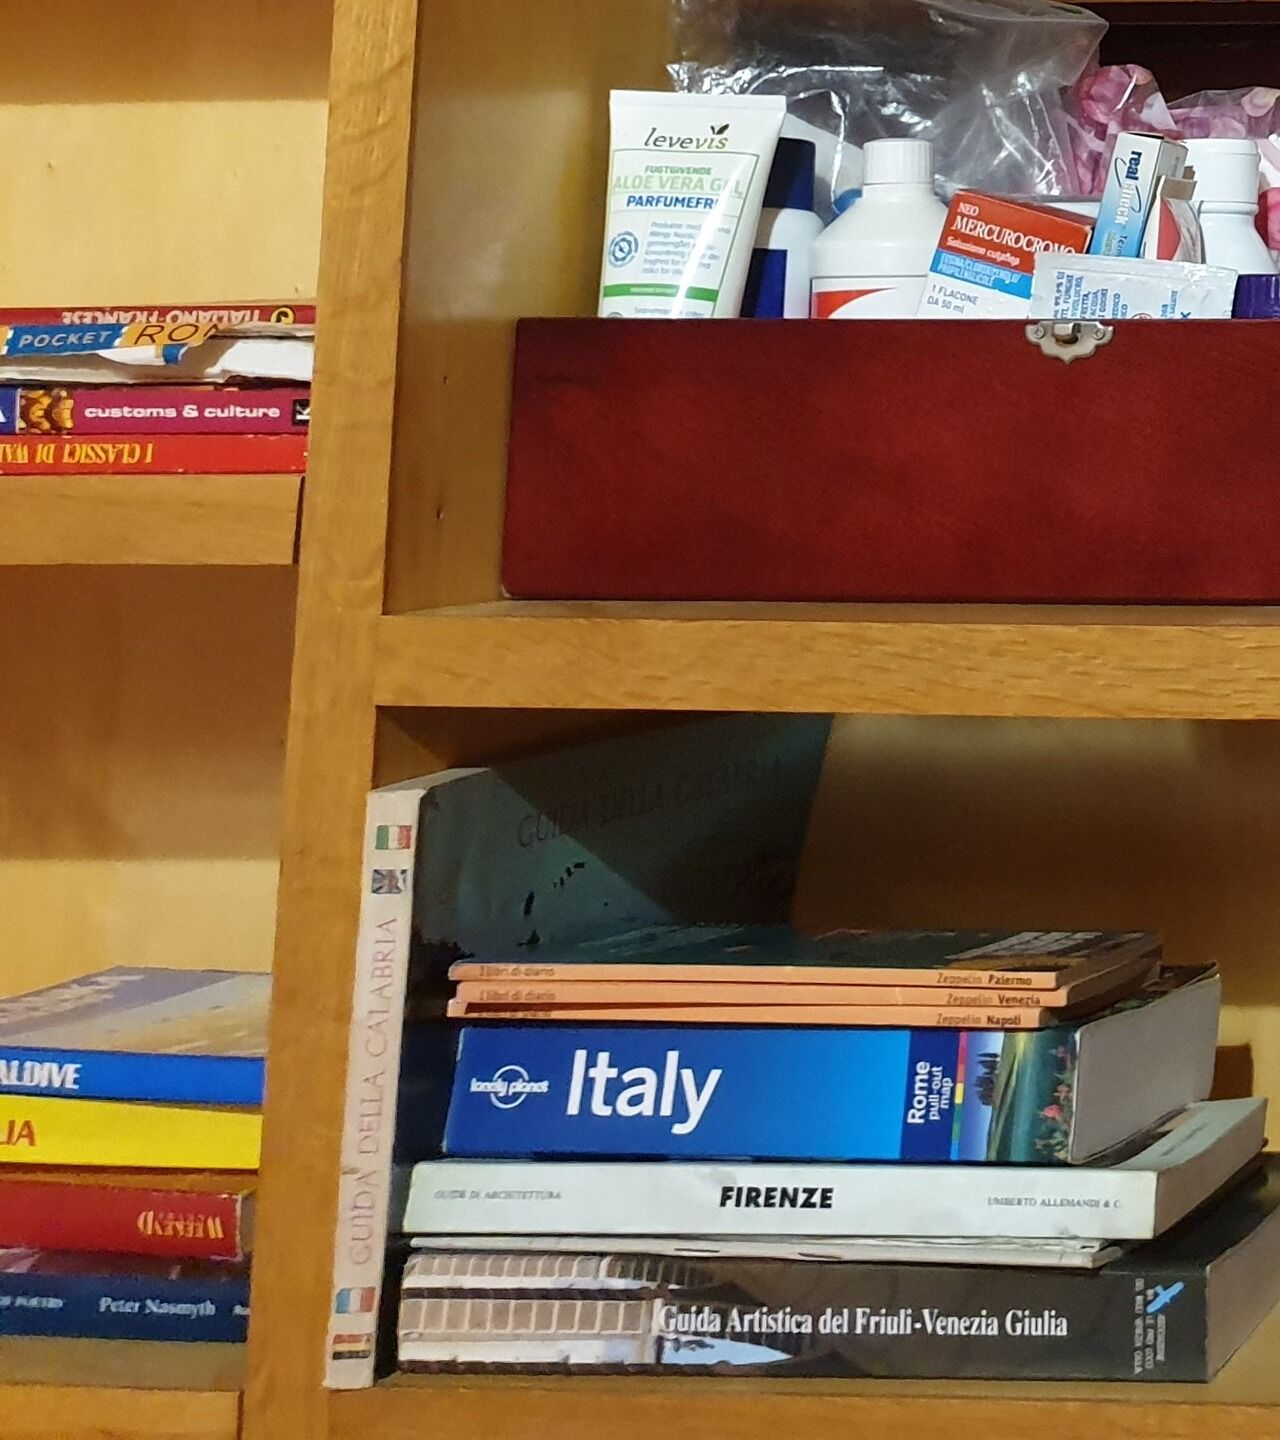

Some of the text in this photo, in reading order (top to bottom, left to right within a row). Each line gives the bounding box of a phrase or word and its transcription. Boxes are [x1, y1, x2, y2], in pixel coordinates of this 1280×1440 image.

[644, 127, 729, 150] levevis
[1125, 150, 1143, 181] real
[613, 175, 656, 192] ALOE
[658, 176, 705, 193] VERA
[956, 202, 979, 216] NEO
[926, 296, 940, 307] DA
[940, 299, 952, 311] 50
[938, 287, 980, 306] FLACONE
[18, 329, 113, 348] POCKET
[84, 404, 281, 419] customs & culture
[35, 442, 57, 464] DI
[63, 442, 143, 464] CLASSICI
[936, 972, 1033, 986] Zeppelin Palermo
[946, 992, 1041, 1006] Zeppelin Venezia
[936, 1012, 1022, 1027] Zeppelin Napoli
[348, 917, 398, 1268] GUIDA DELLA CALABRIA
[565, 1048, 723, 1135] Italy
[906, 1060, 931, 1125] Rome
[928, 1065, 943, 1121] pull-out
[938, 1077, 955, 1110] map
[719, 1185, 834, 1210] FIRENZE
[988, 1197, 1037, 1208] UMBERTO
[1040, 1197, 1100, 1208] ALLEMANDI
[99, 1296, 141, 1313] Peter
[661, 1304, 1068, 1338] Guida Artistica del Friuli-Venezia Giulia
